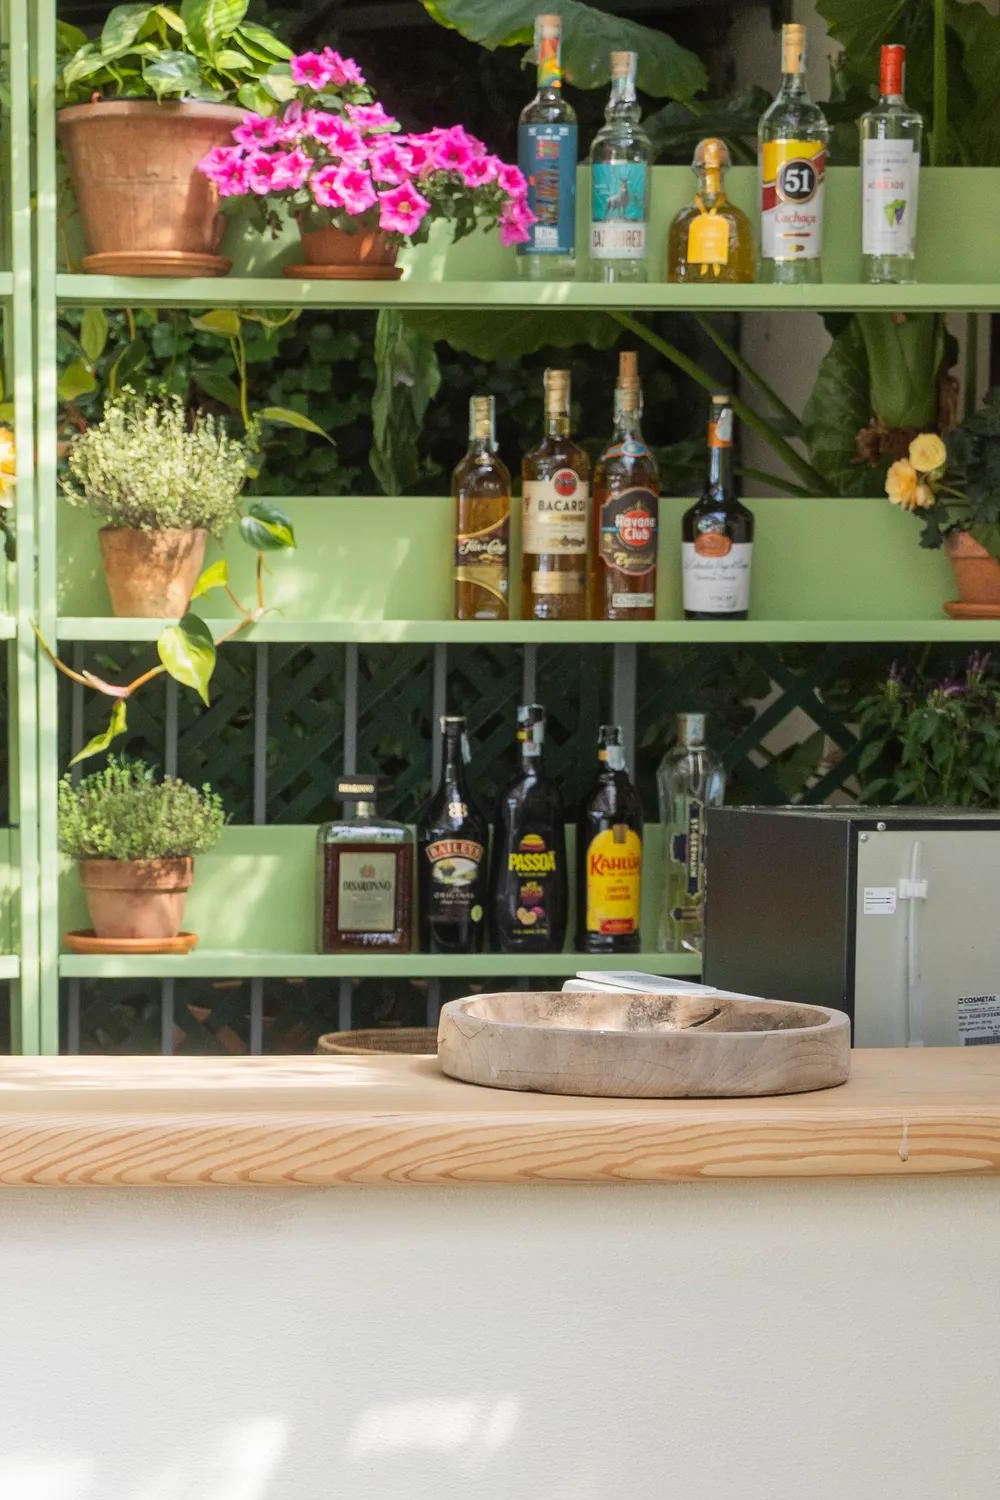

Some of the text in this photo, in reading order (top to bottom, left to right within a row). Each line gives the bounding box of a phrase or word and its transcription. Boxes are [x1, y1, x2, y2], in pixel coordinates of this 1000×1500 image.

[785, 168, 811, 194] 51
[539, 500, 585, 512] BACARDI
[616, 513, 655, 530] Havana
[624, 525, 649, 540] Club
[427, 840, 481, 859] BAILEYS
[343, 880, 392, 892] DISARONNO
[964, 996, 996, 1005] COSMETAL
